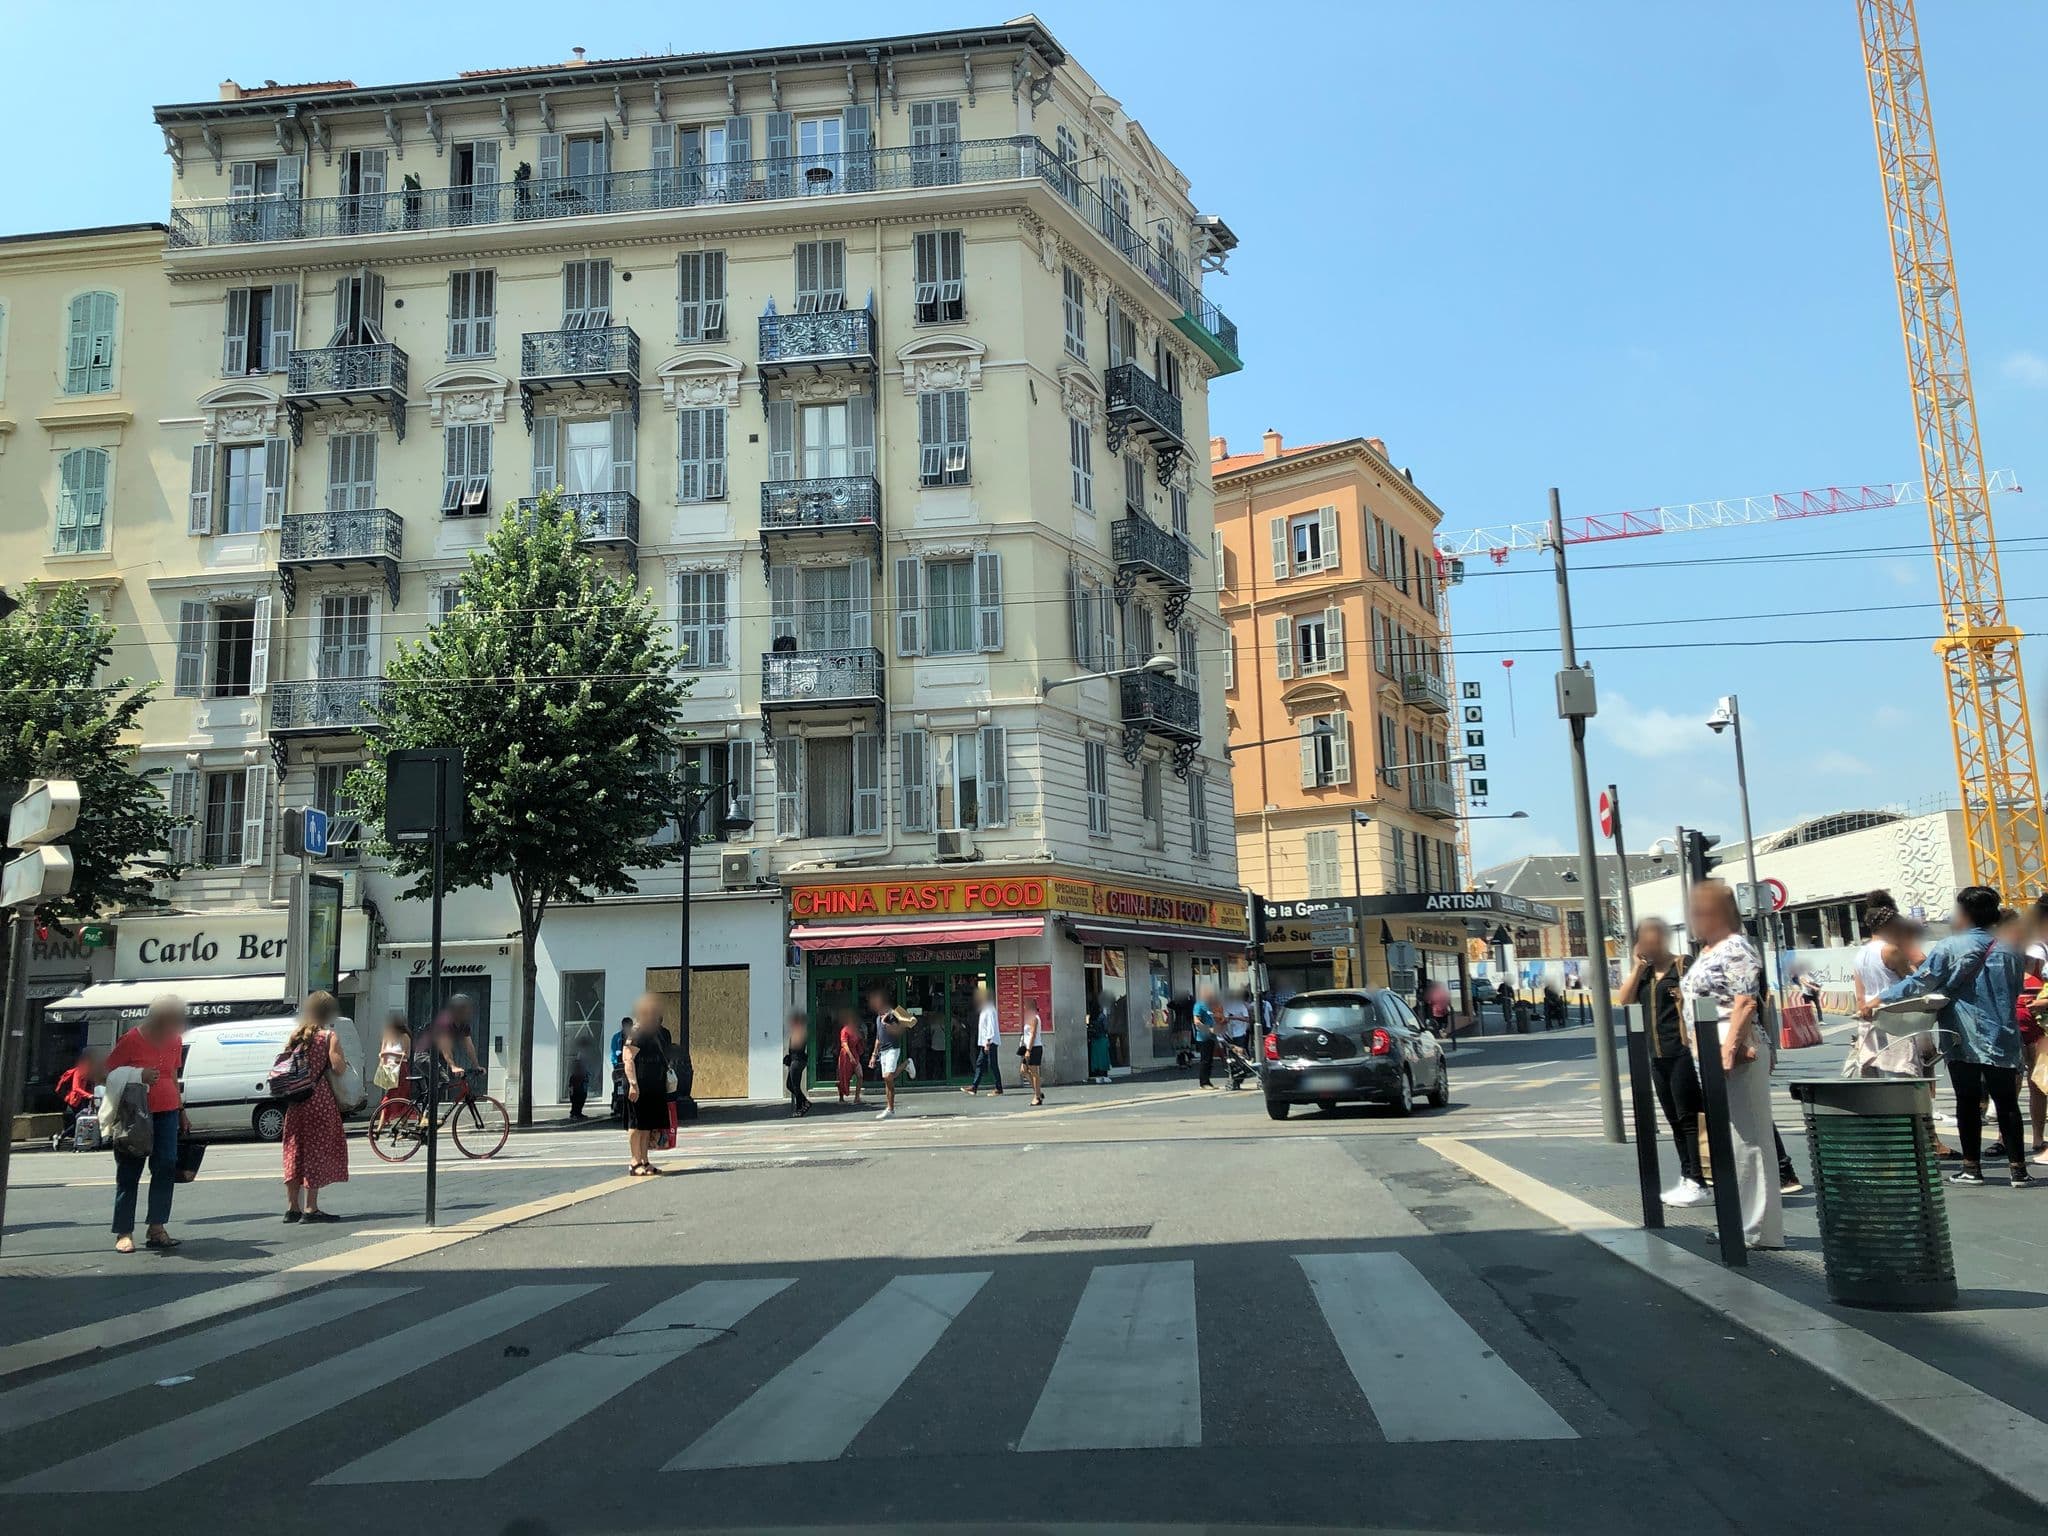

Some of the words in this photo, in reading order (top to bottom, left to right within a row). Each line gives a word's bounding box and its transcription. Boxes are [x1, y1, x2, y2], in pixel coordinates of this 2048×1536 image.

[1463, 682, 1487, 795] HOTEL
[793, 888, 878, 914] CHINA
[885, 885, 955, 911] FAST
[964, 881, 1044, 908] FOOD
[1110, 891, 1147, 916] CHINA
[1150, 896, 1177, 919] FAST
[1426, 894, 1492, 910] ARTISAN
[1280, 904, 1293, 918] la
[1296, 901, 1329, 916] Gare
[138, 932, 219, 964] Carlo
[391, 950, 402, 959] 51
[498, 946, 509, 956] 51
[192, 1005, 201, 1015] &
[203, 1004, 232, 1015] SACS
